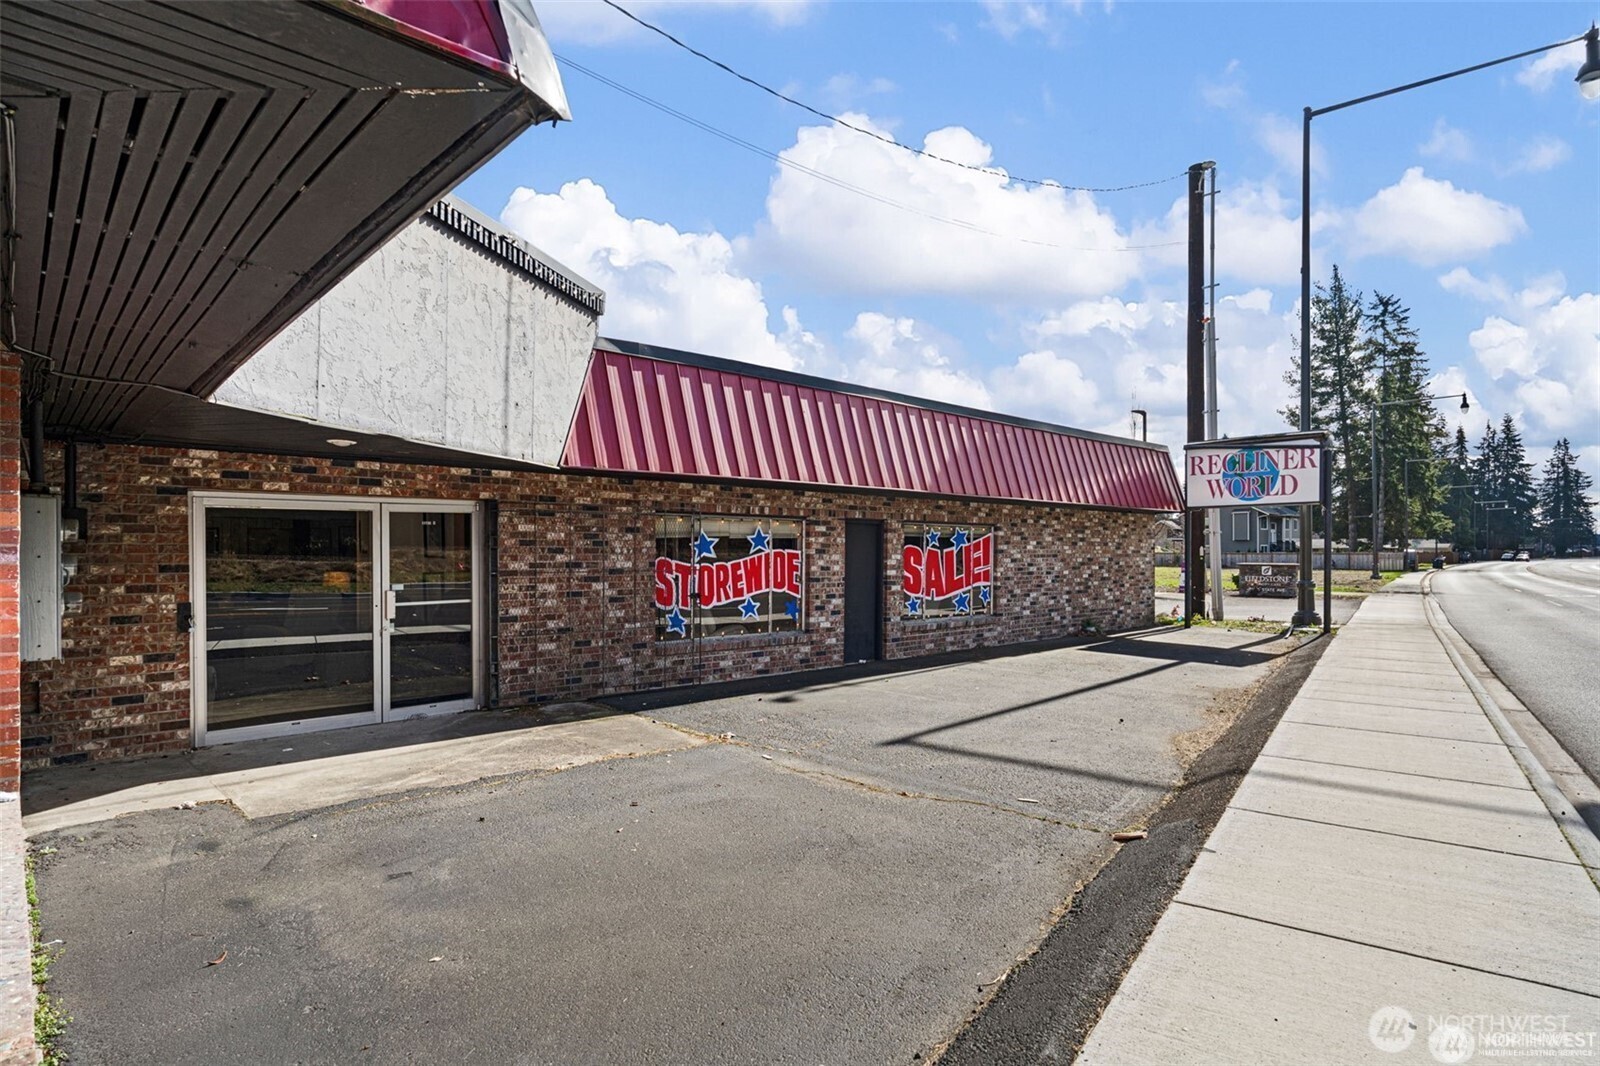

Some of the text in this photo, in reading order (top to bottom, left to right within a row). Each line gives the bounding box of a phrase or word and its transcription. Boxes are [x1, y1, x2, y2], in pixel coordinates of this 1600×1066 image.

[1190, 448, 1317, 476] RECLINER
[1207, 474, 1299, 499] WORLD
[655, 549, 801, 610] STOREWIDE
[904, 533, 992, 600] SALE!
